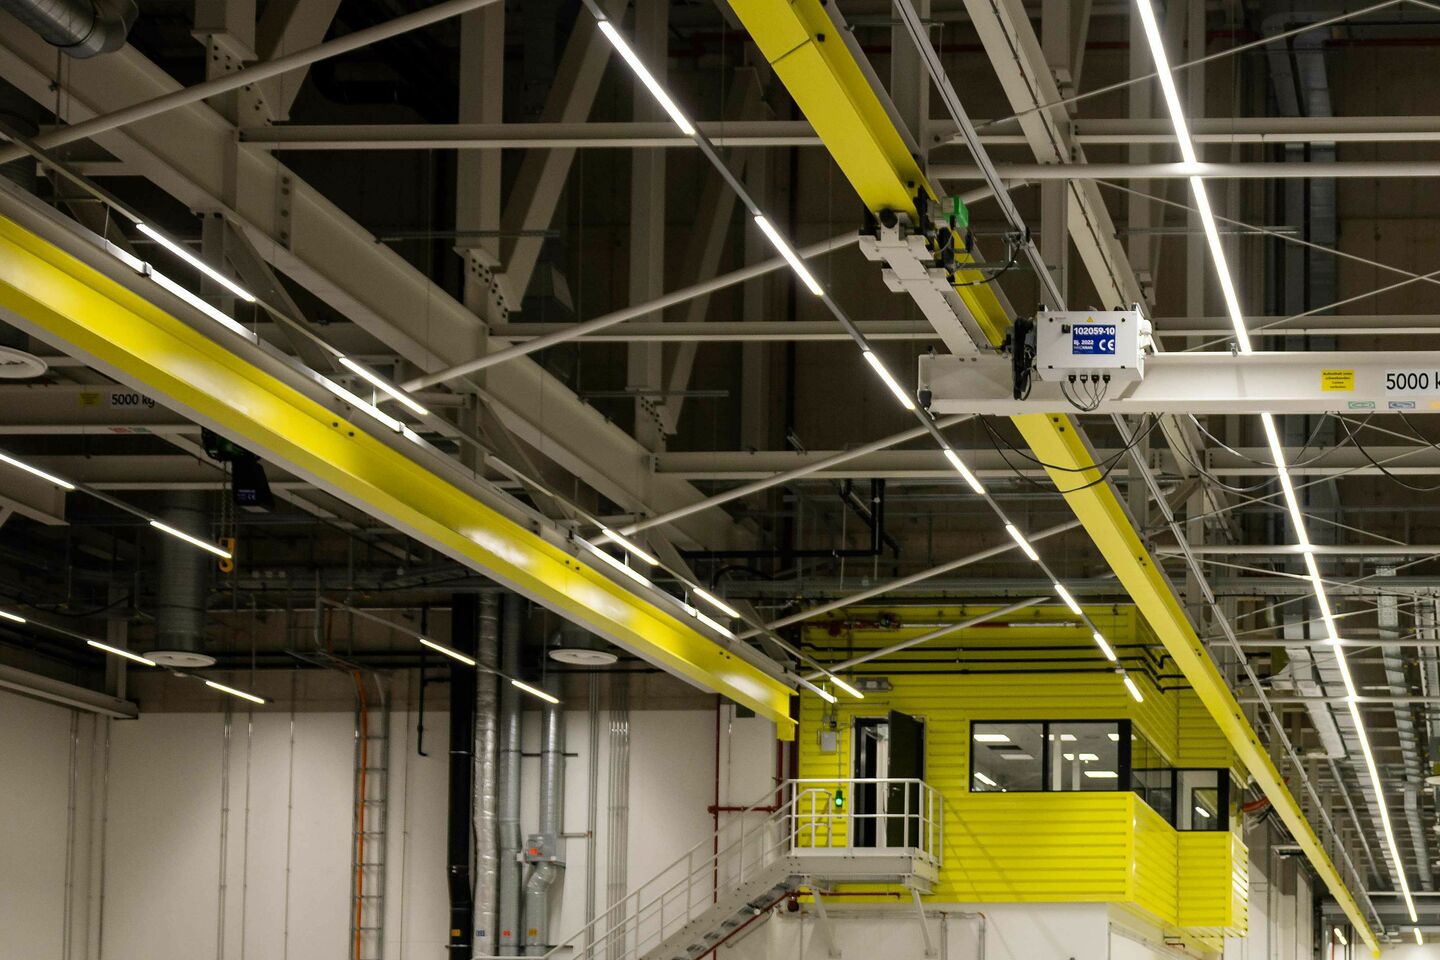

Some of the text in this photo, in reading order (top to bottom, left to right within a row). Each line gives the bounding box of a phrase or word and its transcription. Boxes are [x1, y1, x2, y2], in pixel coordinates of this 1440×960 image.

[1073, 327, 1115, 335] 102059-10
[1386, 373, 1429, 390] 5000
[112, 394, 139, 405] 5000
[142, 394, 155, 408] kg
